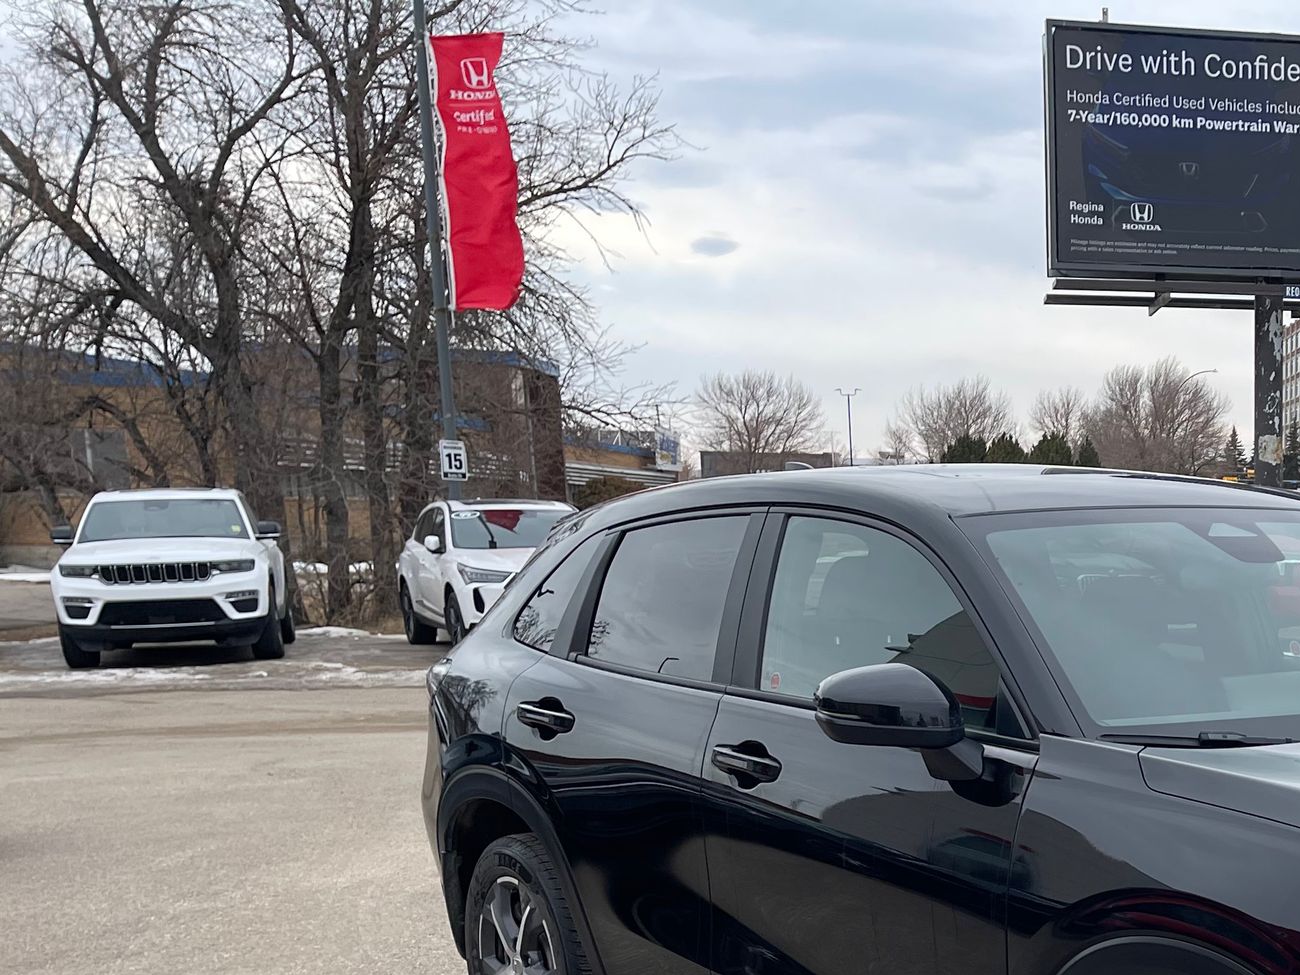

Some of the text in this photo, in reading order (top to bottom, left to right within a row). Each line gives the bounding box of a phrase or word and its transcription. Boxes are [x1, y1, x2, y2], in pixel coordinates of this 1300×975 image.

[1066, 45, 1132, 73] Drive
[1141, 50, 1195, 76] with
[450, 90, 496, 100] HOND
[1067, 89, 1110, 105] Honda
[1113, 92, 1169, 108] Certified
[1173, 95, 1205, 110] Used
[1209, 98, 1263, 113] Vehicles
[1067, 109, 1169, 128] 7-Year/160,000
[1172, 114, 1194, 129] km
[1197, 117, 1271, 133] Powertrain
[1070, 201, 1104, 213] Regina
[1071, 214, 1103, 225] Honda
[1122, 223, 1162, 231] HONDA
[445, 453, 463, 470] 15
